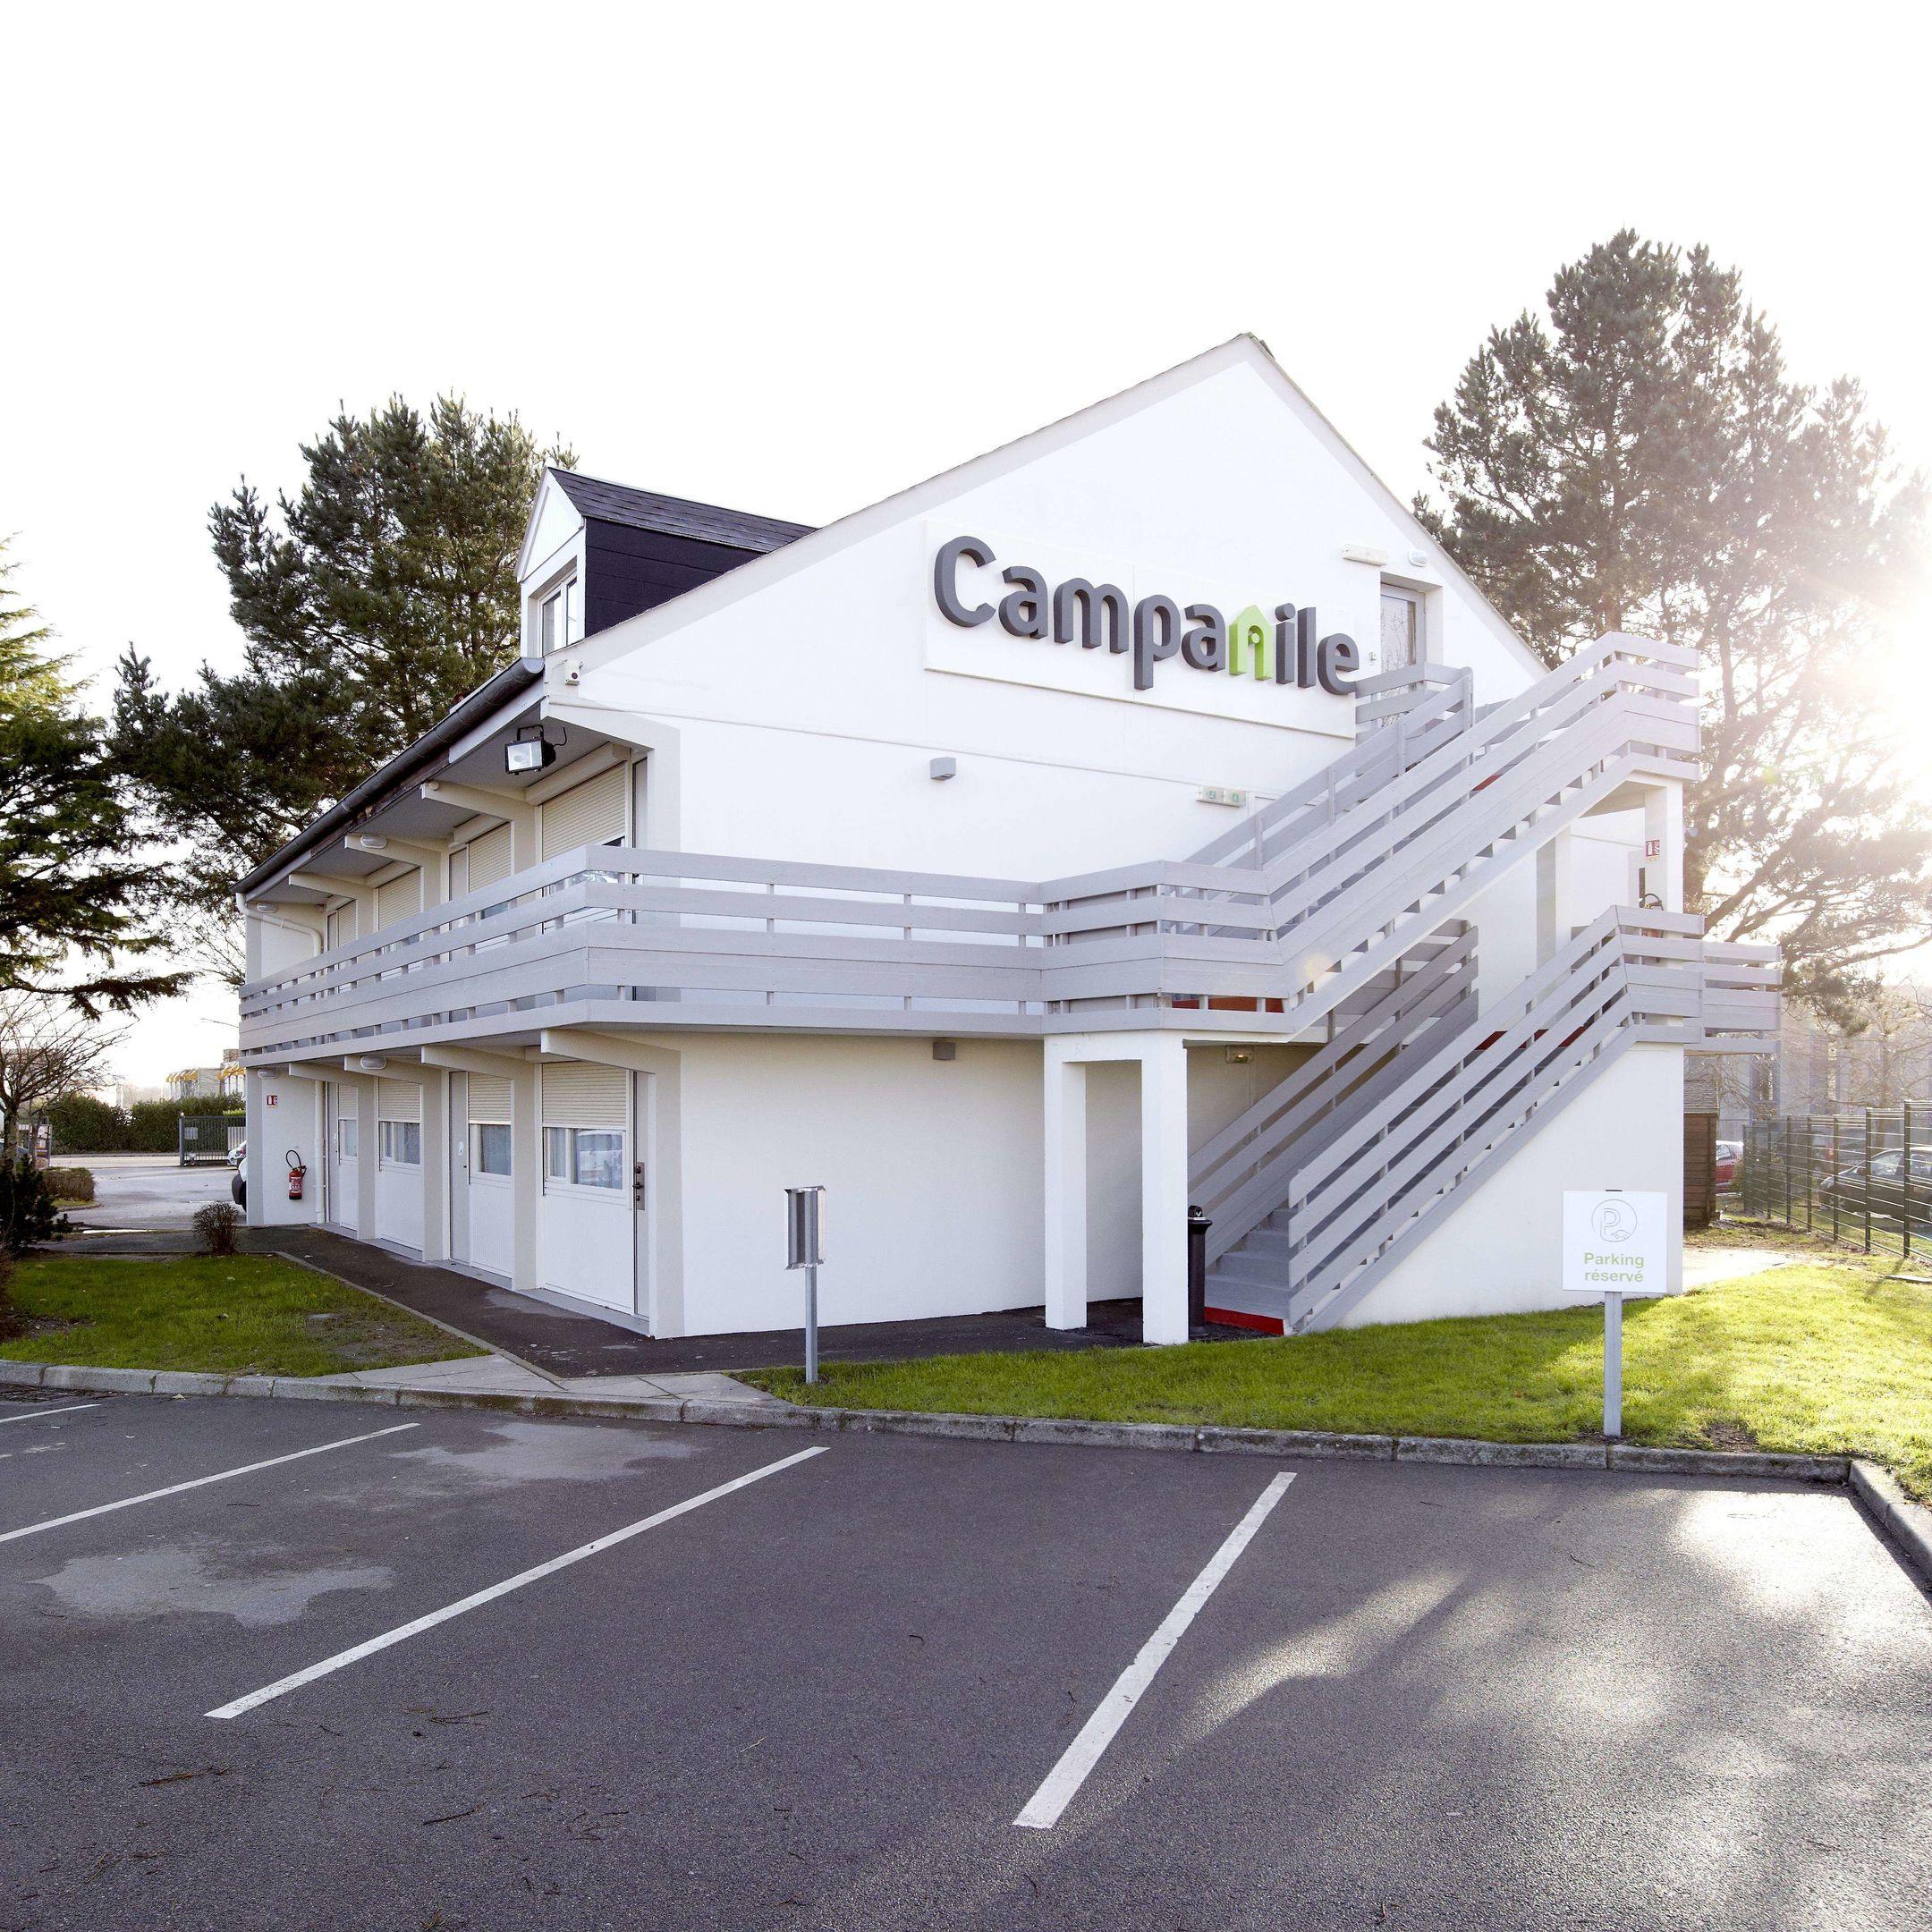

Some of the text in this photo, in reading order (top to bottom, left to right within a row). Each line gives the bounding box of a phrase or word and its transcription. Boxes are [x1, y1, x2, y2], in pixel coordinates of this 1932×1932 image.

[934, 536, 1360, 696] Campanile
[1584, 1252, 1645, 1269] Parking
[1584, 1268, 1644, 1283] réservé
